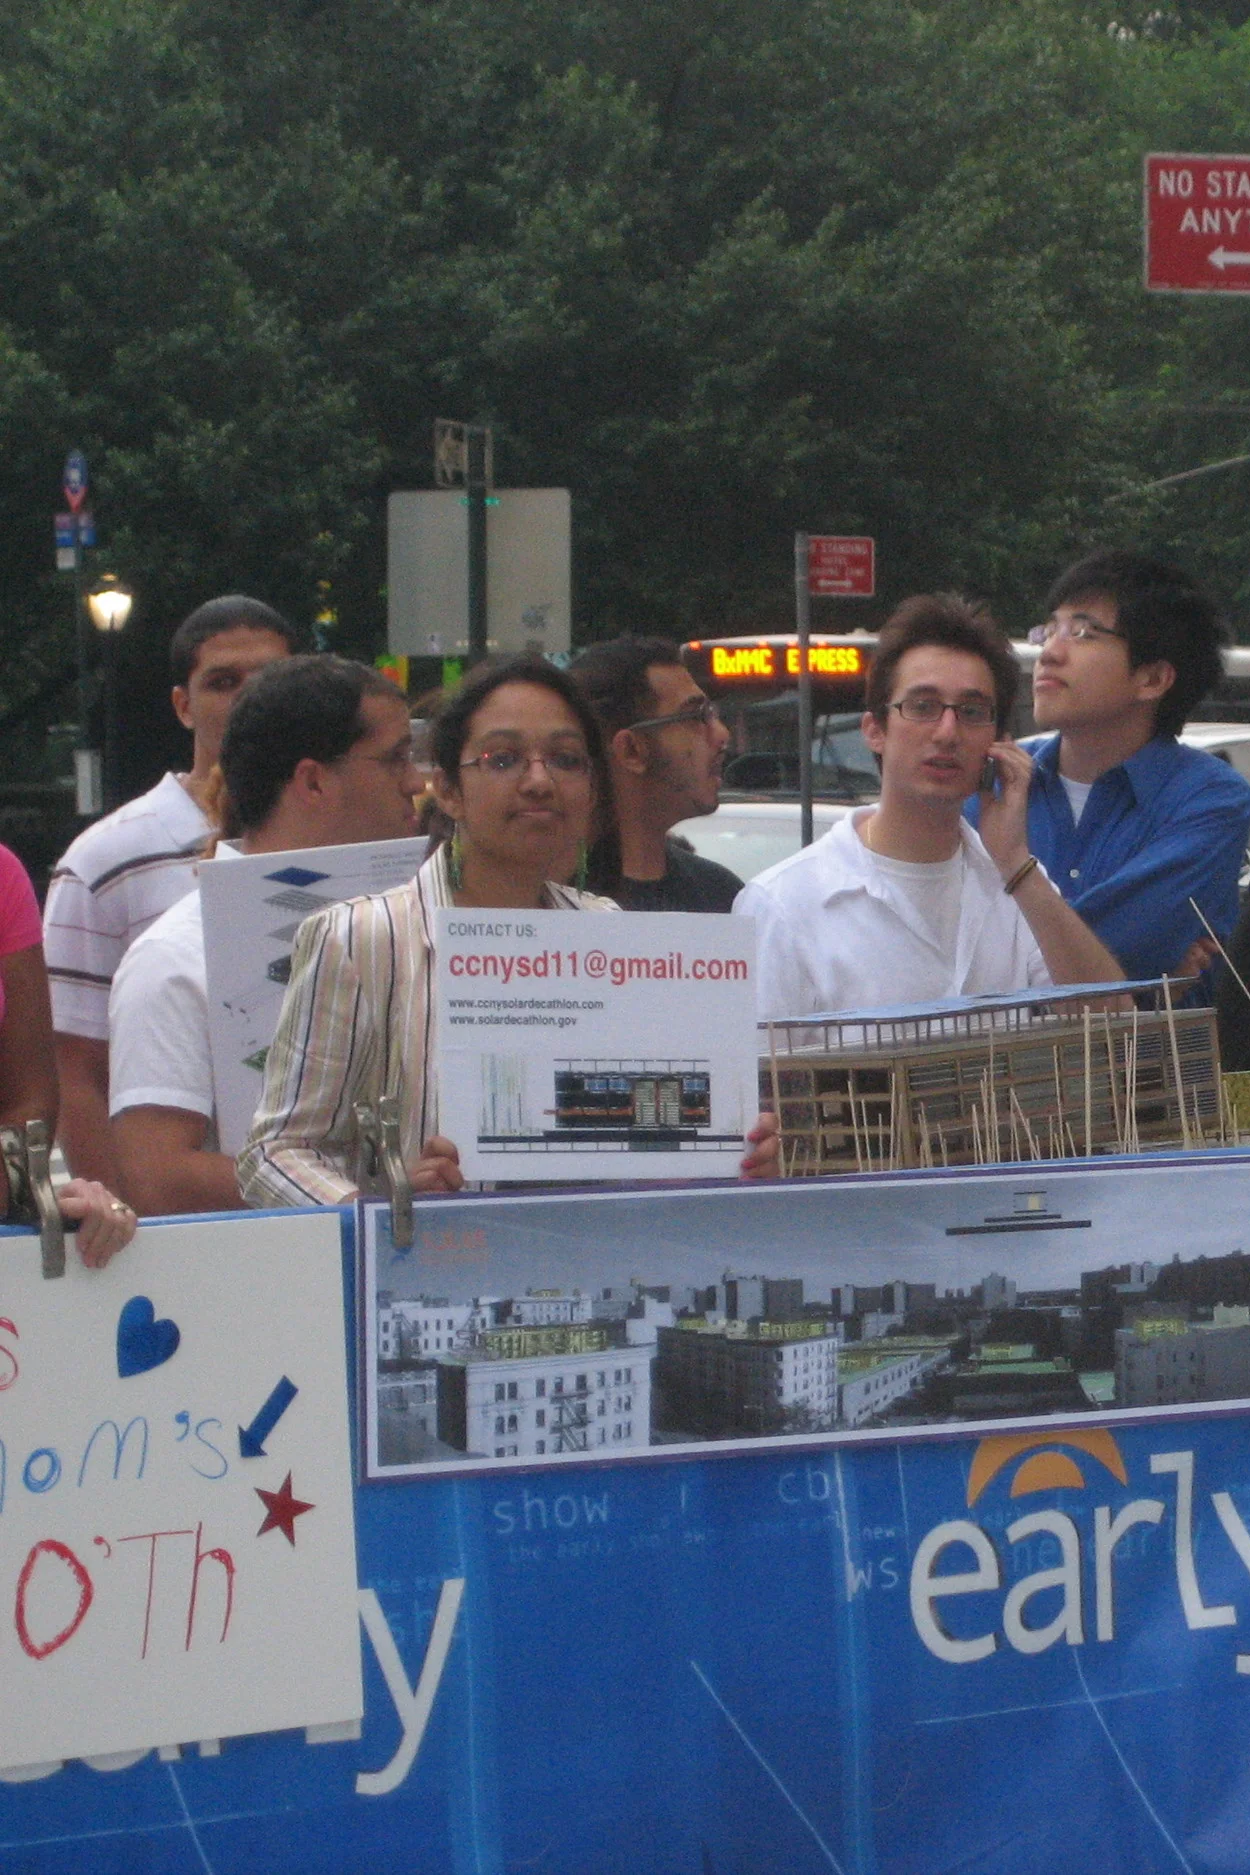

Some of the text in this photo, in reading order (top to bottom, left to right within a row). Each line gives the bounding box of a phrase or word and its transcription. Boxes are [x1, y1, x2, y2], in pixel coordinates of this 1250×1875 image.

[1159, 169, 1194, 197] NO
[713, 647, 860, 676] BxM4C EPRESS
[448, 922, 538, 938] CONTACT US:
[449, 948, 749, 986] ccnysd11@gmail.com
[449, 997, 604, 1011] www.ccnysolardecathlon.com
[449, 1014, 578, 1029] www.solardecathlon.gov
[492, 1489, 610, 1537] show
